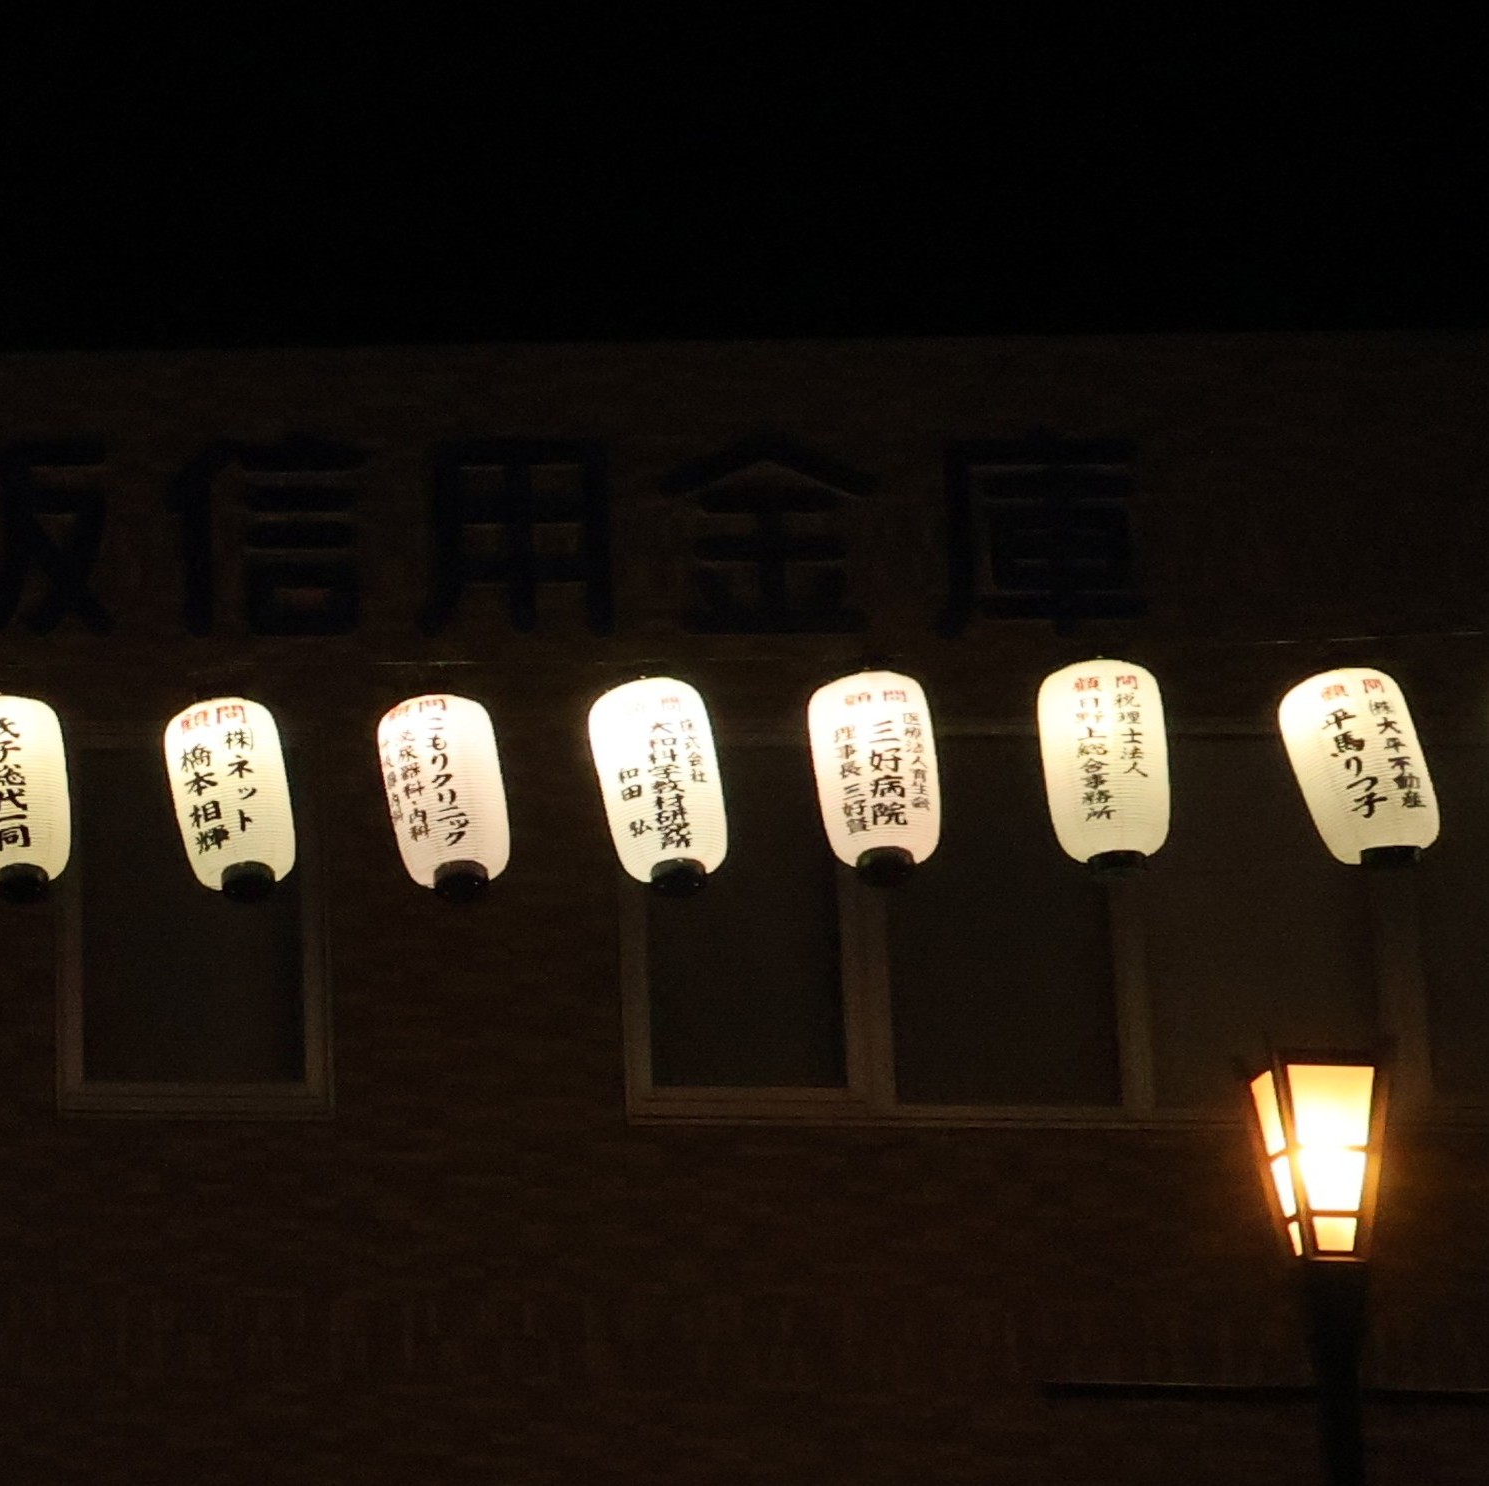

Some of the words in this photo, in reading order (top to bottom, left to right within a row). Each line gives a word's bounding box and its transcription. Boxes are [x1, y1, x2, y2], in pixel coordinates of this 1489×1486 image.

[426, 717, 470, 847] こもりクリニック
[869, 720, 909, 826] 三好病院
[1114, 692, 1149, 778] 税理士法人
[1321, 708, 1389, 819] 平馬りつ子
